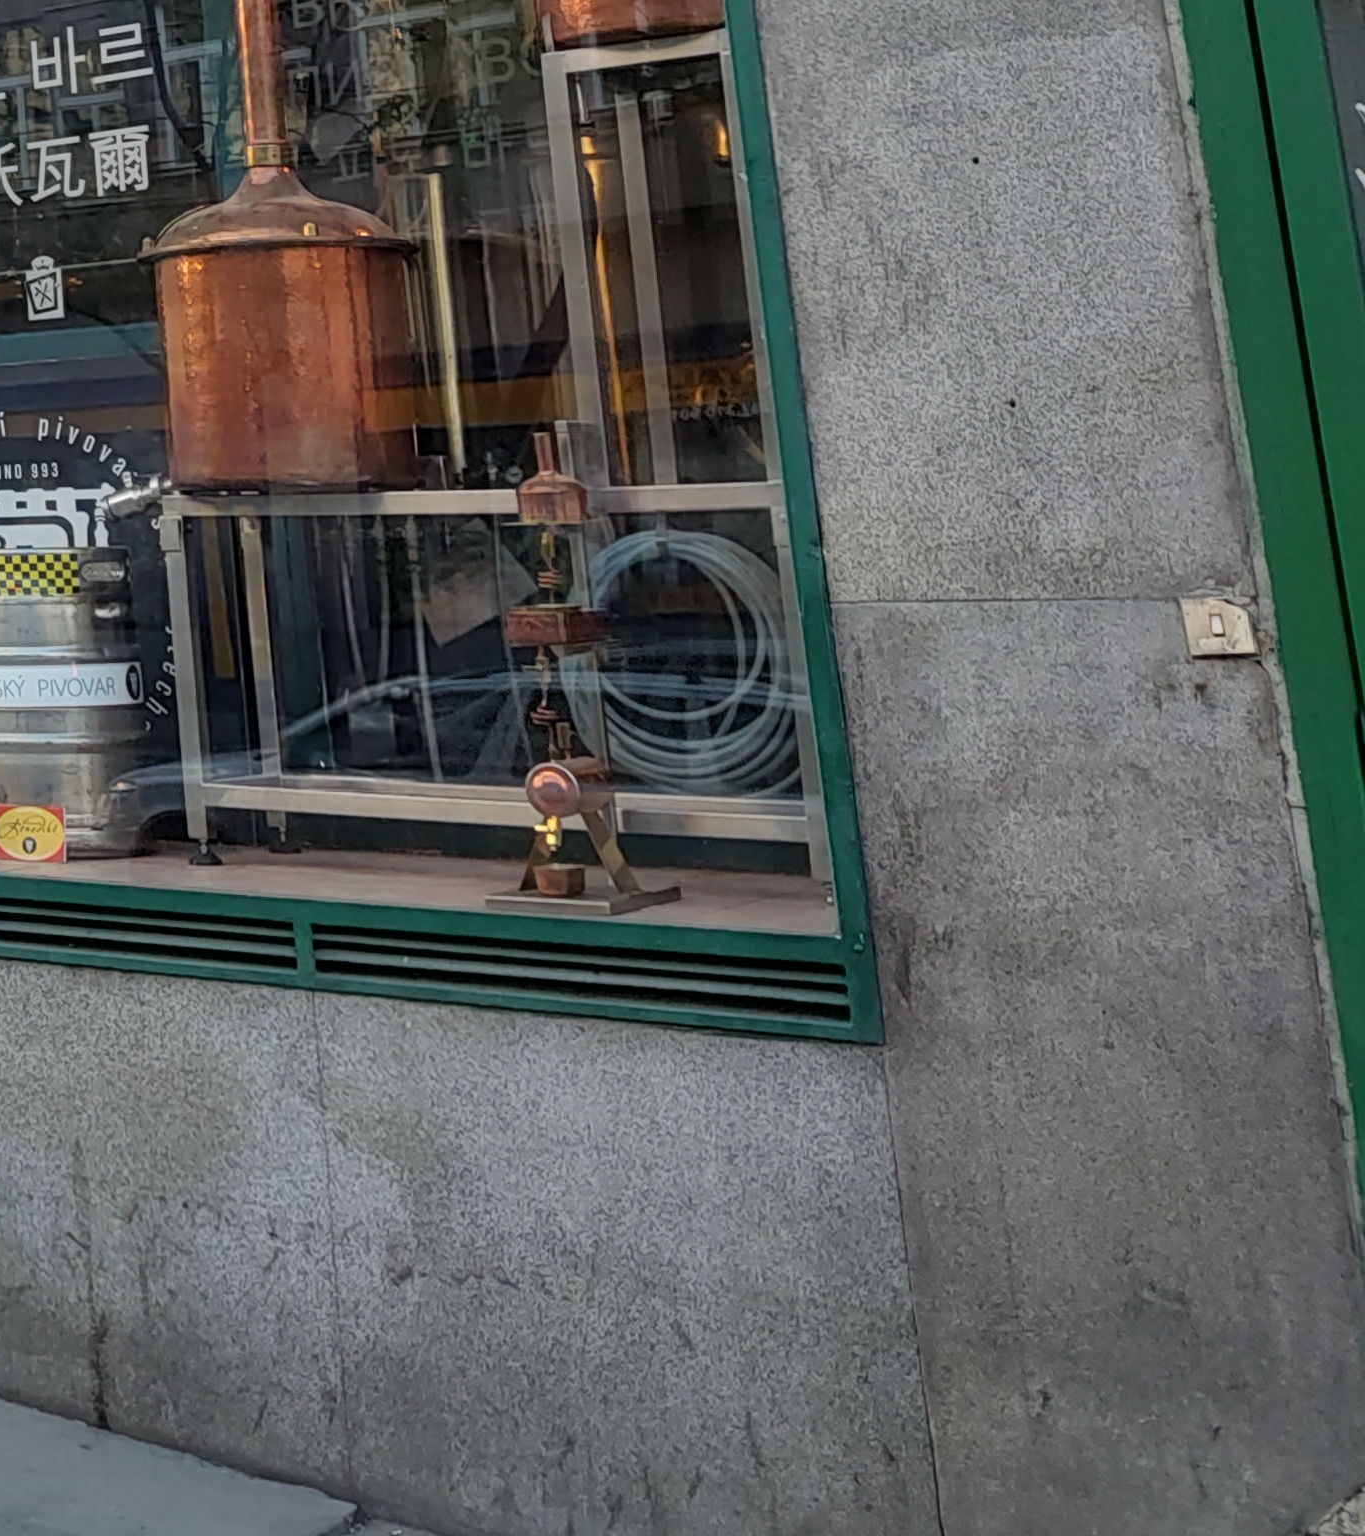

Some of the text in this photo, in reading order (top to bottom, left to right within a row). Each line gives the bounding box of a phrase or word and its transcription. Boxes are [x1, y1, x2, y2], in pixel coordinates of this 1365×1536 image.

[29, 22, 155, 96] 바르
[37, 415, 128, 480] pivova
[30, 462, 60, 479] 993
[38, 676, 116, 699] PIVOVAR
